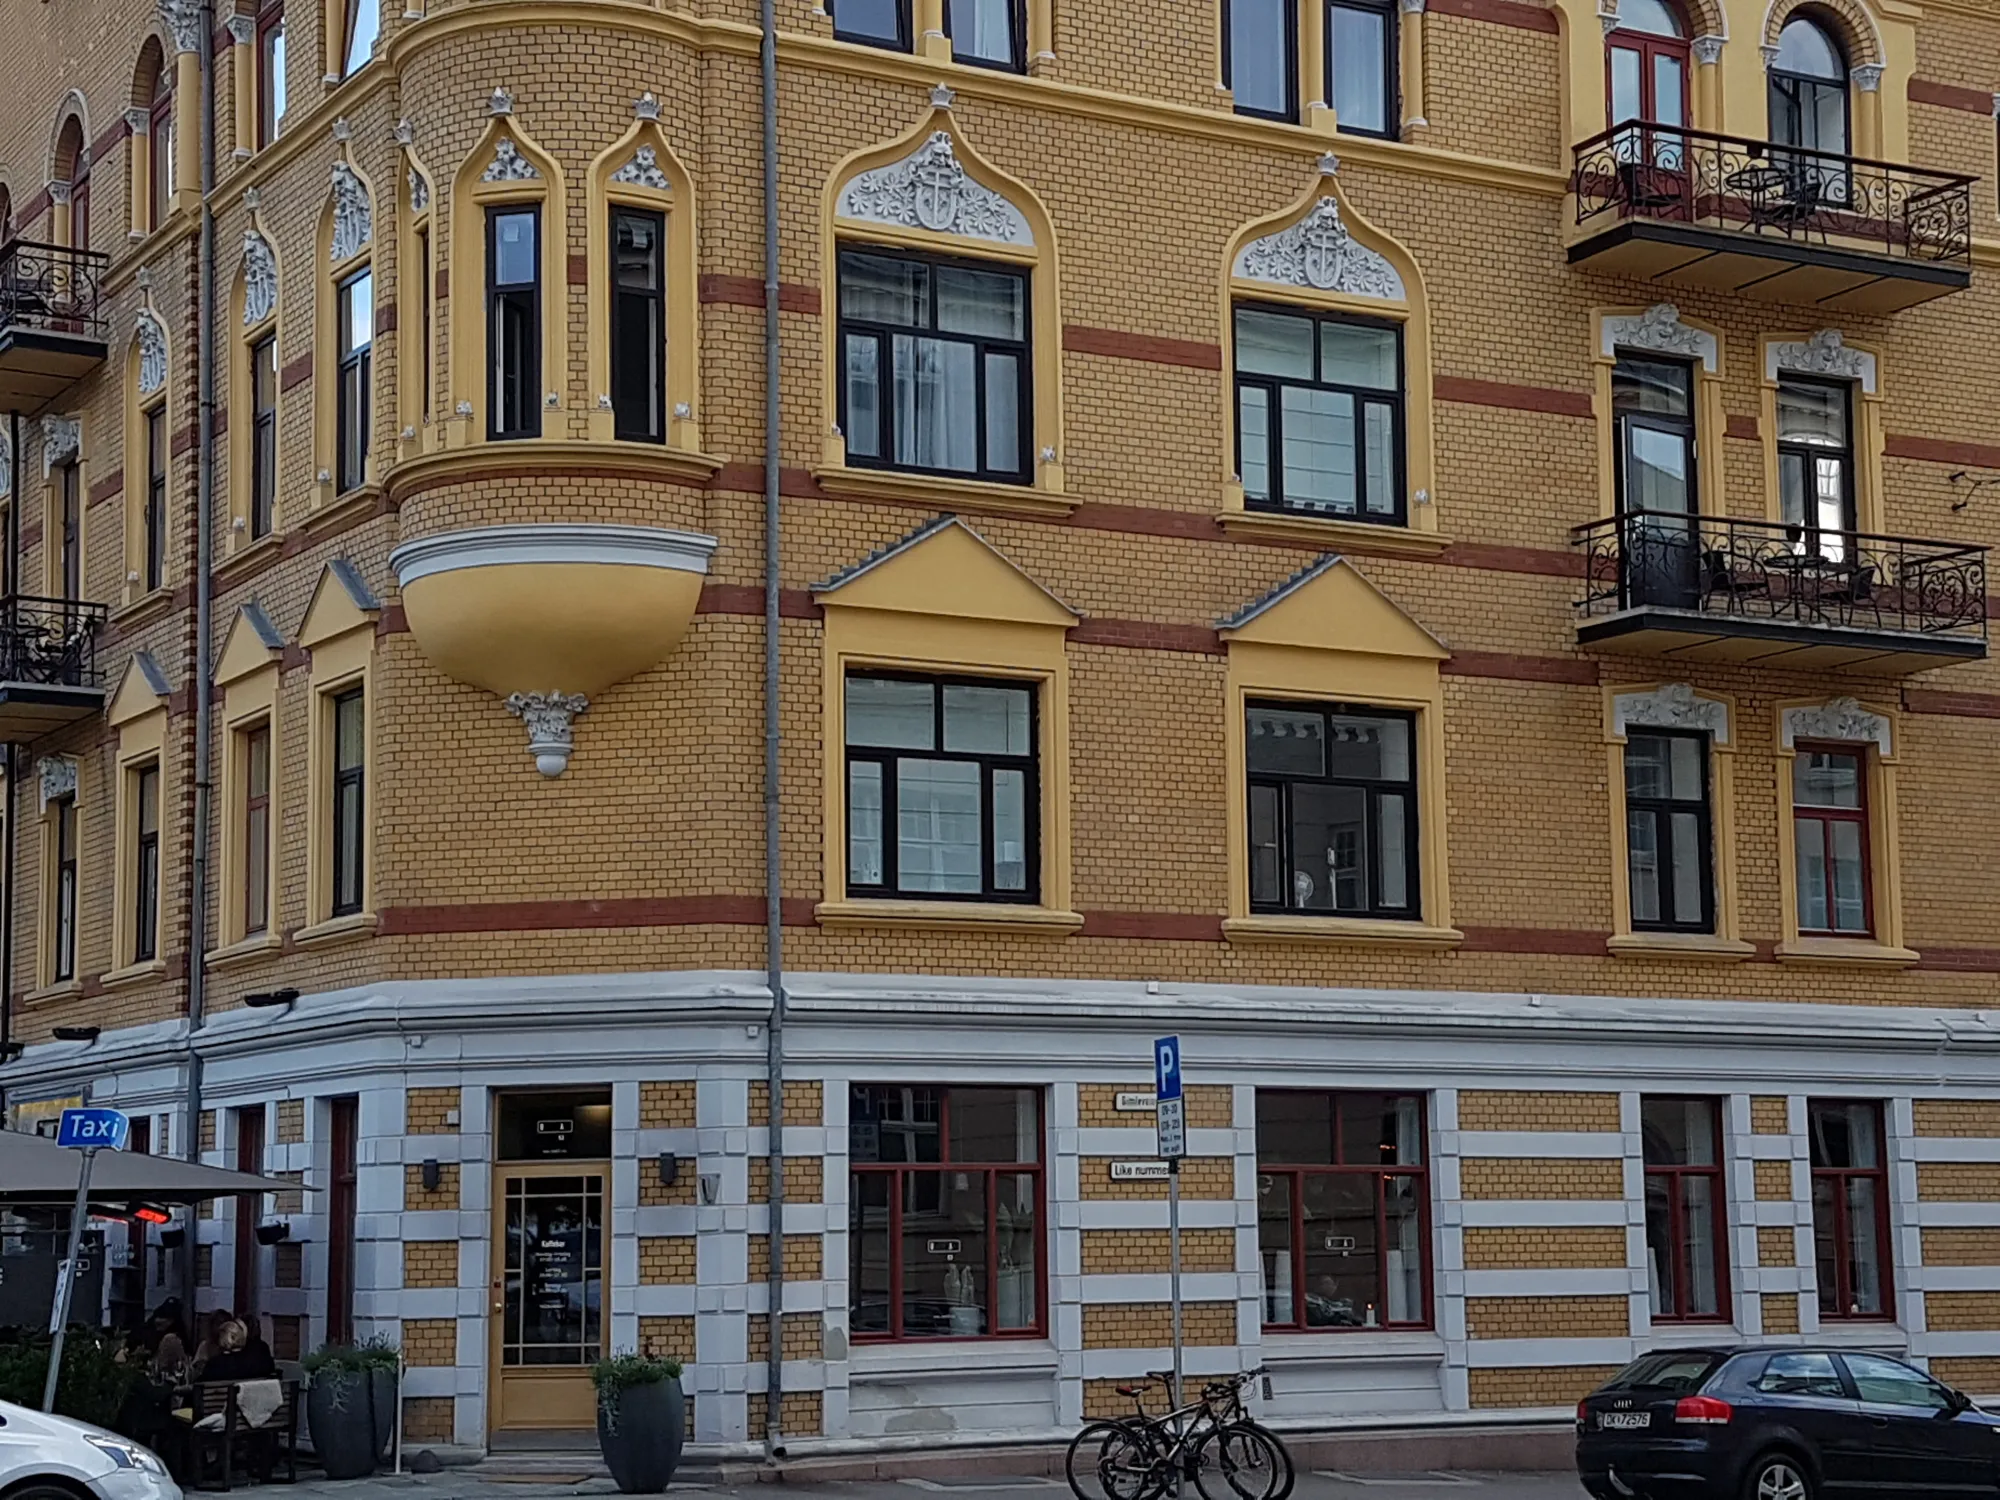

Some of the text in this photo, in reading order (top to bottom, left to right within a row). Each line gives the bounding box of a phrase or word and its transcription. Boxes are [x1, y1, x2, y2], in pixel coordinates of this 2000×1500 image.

[1160, 1045, 1174, 1093] P
[70, 1114, 120, 1138] Taxi
[1114, 1164, 1170, 1176] Like numme
